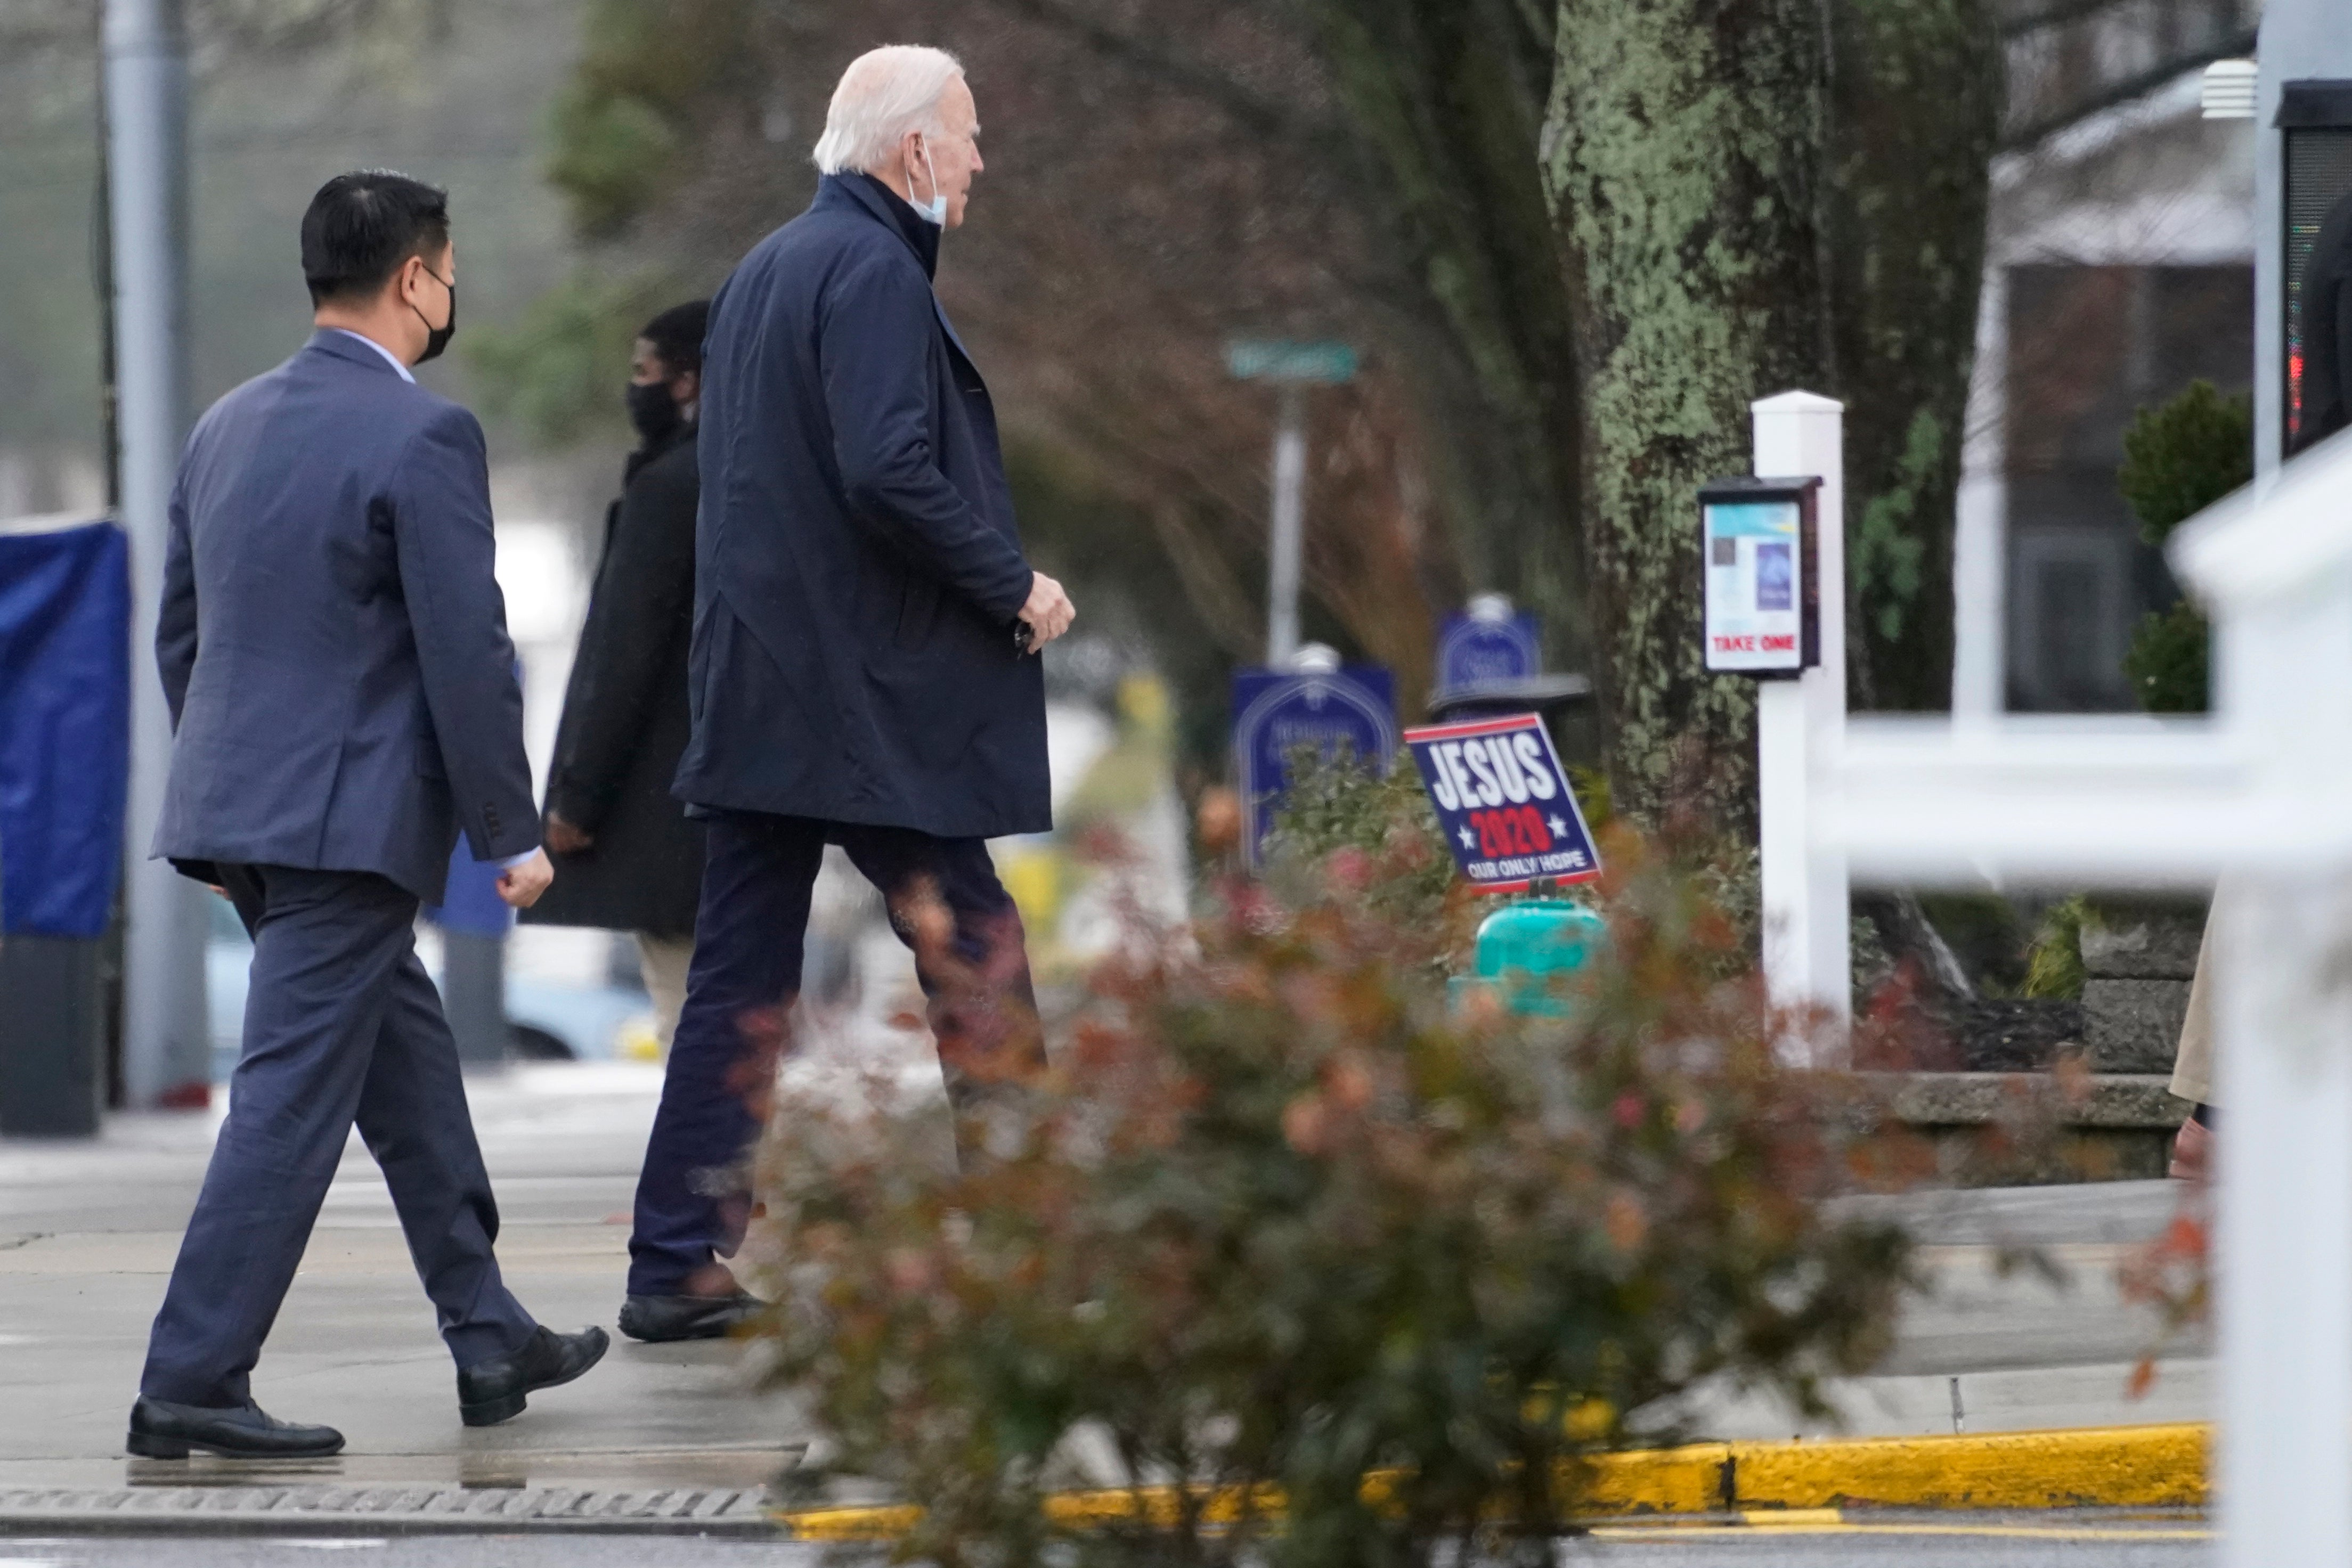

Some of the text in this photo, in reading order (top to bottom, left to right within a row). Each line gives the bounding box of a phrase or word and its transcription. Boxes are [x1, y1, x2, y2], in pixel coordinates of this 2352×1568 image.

[1712, 634, 1795, 652] TAKE ONE
[1428, 731, 1557, 812] JESUS
[1469, 804, 1552, 859] 2020
[1467, 848, 1588, 879] OUR ONLY HOPE
